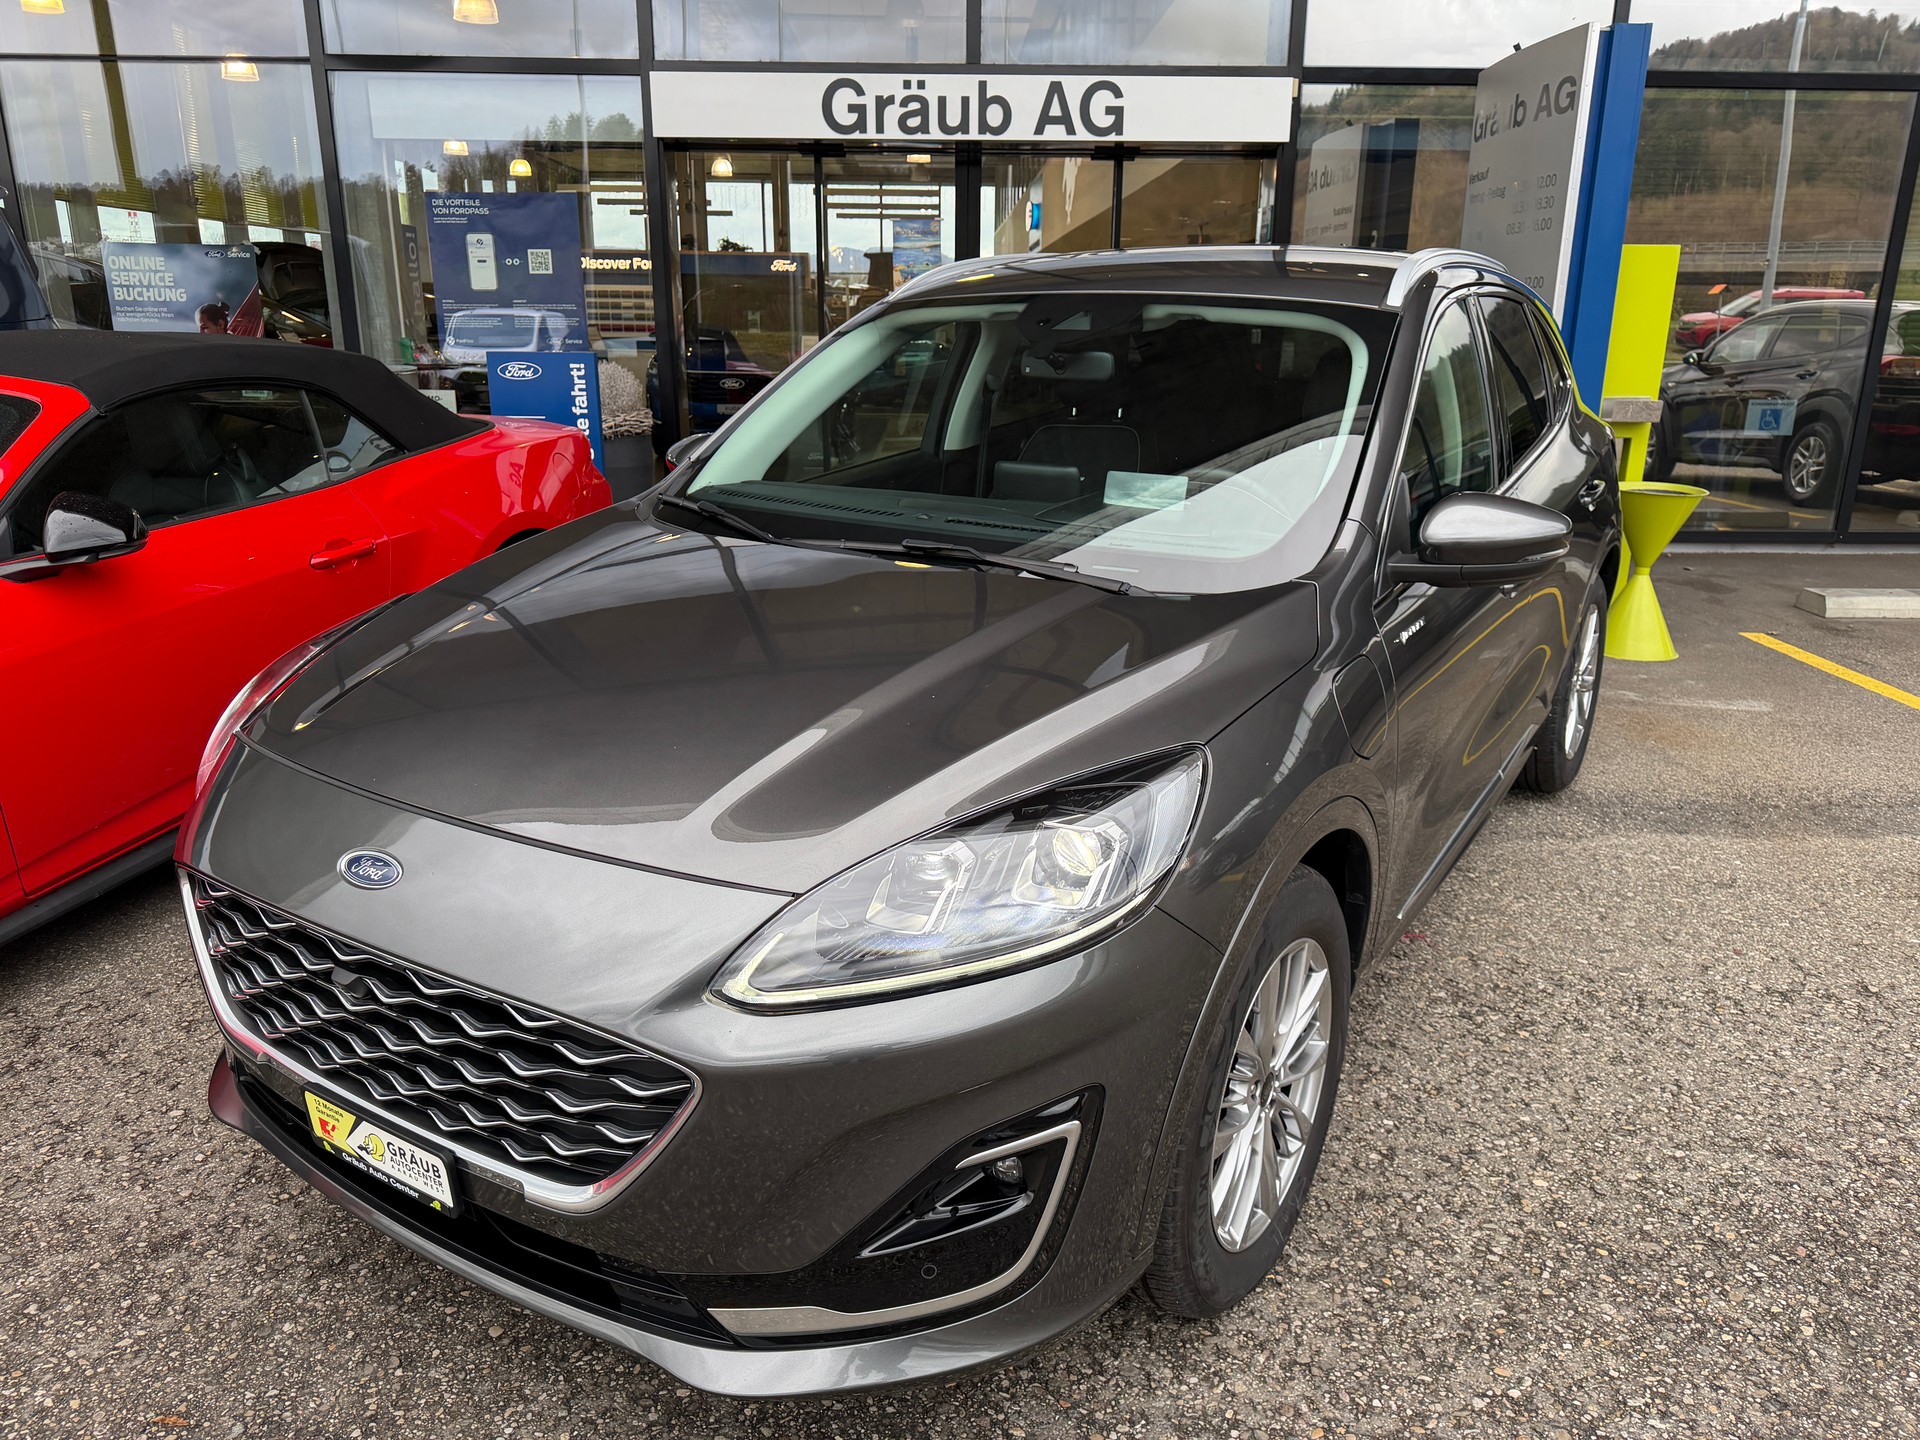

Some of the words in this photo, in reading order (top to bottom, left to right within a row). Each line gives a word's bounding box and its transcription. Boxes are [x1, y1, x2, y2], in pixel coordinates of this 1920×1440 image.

[822, 77, 1012, 136] Gräub
[1033, 79, 1125, 137] AG
[1473, 94, 1527, 143] Gräb
[1533, 75, 1577, 122] AG
[431, 198, 443, 206] DIE
[444, 198, 481, 206] VORTEILE
[432, 207, 449, 215] VON
[450, 207, 490, 215] FORDPASS
[108, 255, 166, 271] ONLINE
[227, 250, 251, 259] Service
[770, 259, 797, 272] Ford
[111, 271, 175, 286] SERVICE
[113, 286, 187, 302] BUCHUNG
[505, 364, 534, 378] Ford
[569, 363, 589, 416] fahrt!
[351, 857, 388, 880] Ford
[386, 1141, 442, 1179] GRÄUB
[342, 1152, 368, 1171] Gräub
[369, 1166, 388, 1182] Auto
[389, 1178, 419, 1198] Center
[390, 1156, 444, 1189] AUTOCENTER
[391, 1164, 418, 1181] AARAU
[423, 1181, 445, 1195] WEST
